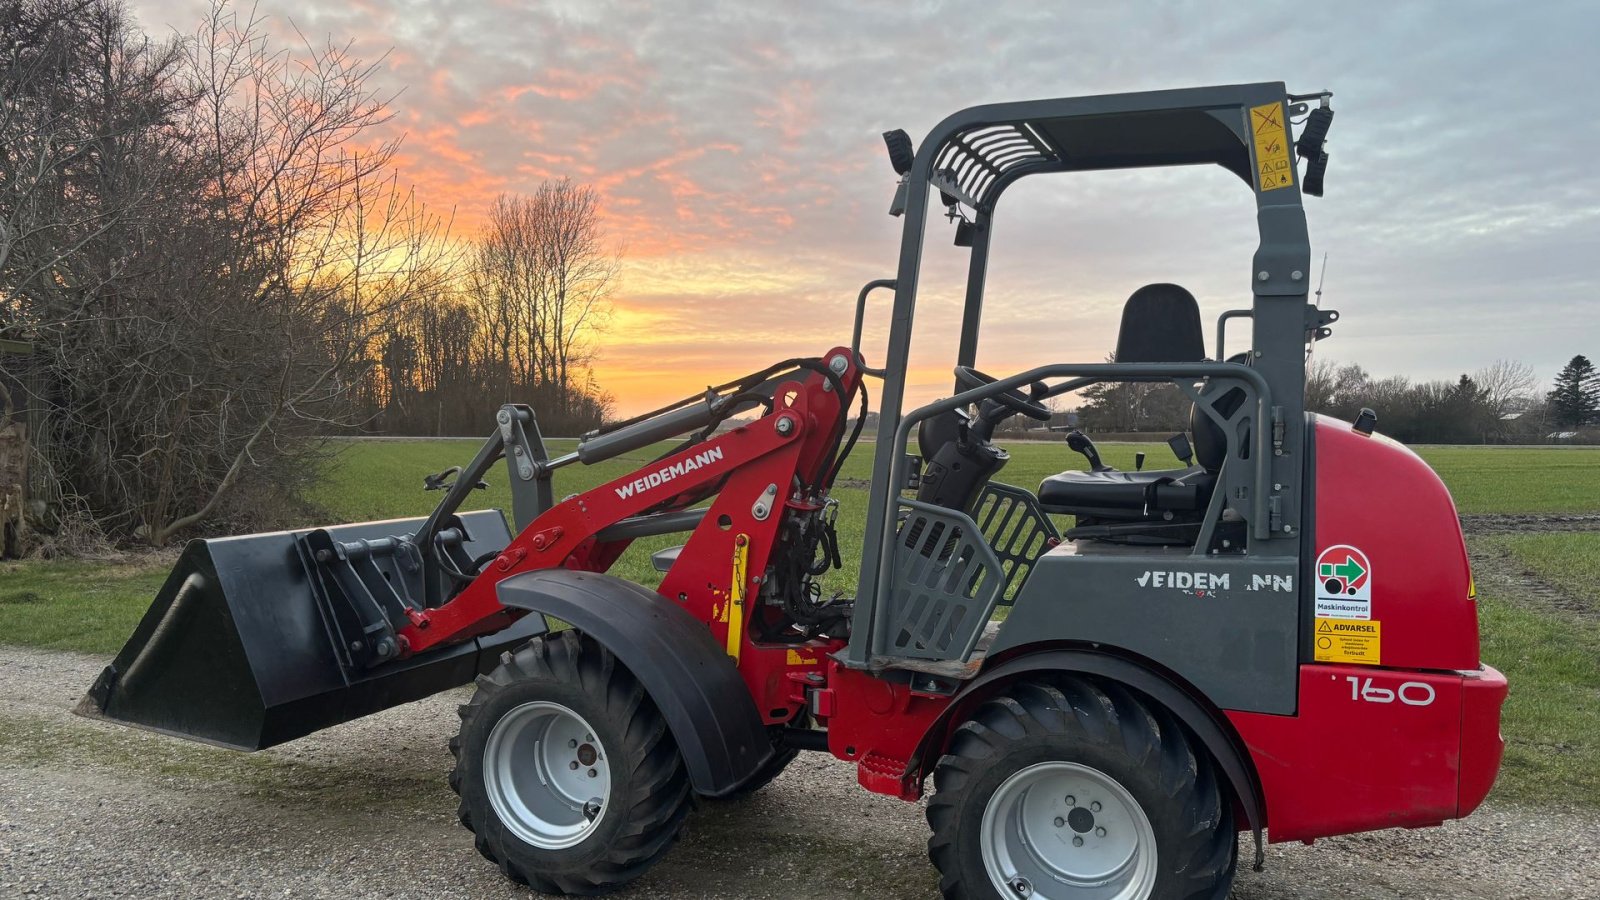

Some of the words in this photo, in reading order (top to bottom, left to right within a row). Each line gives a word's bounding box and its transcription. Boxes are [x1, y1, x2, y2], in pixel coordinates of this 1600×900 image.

[614, 445, 724, 500] WEIDEMANN
[1134, 571, 1293, 592] EIDEMNN
[1317, 603, 1368, 612] Maskinkontrol
[1333, 623, 1376, 633] ADVARSEL
